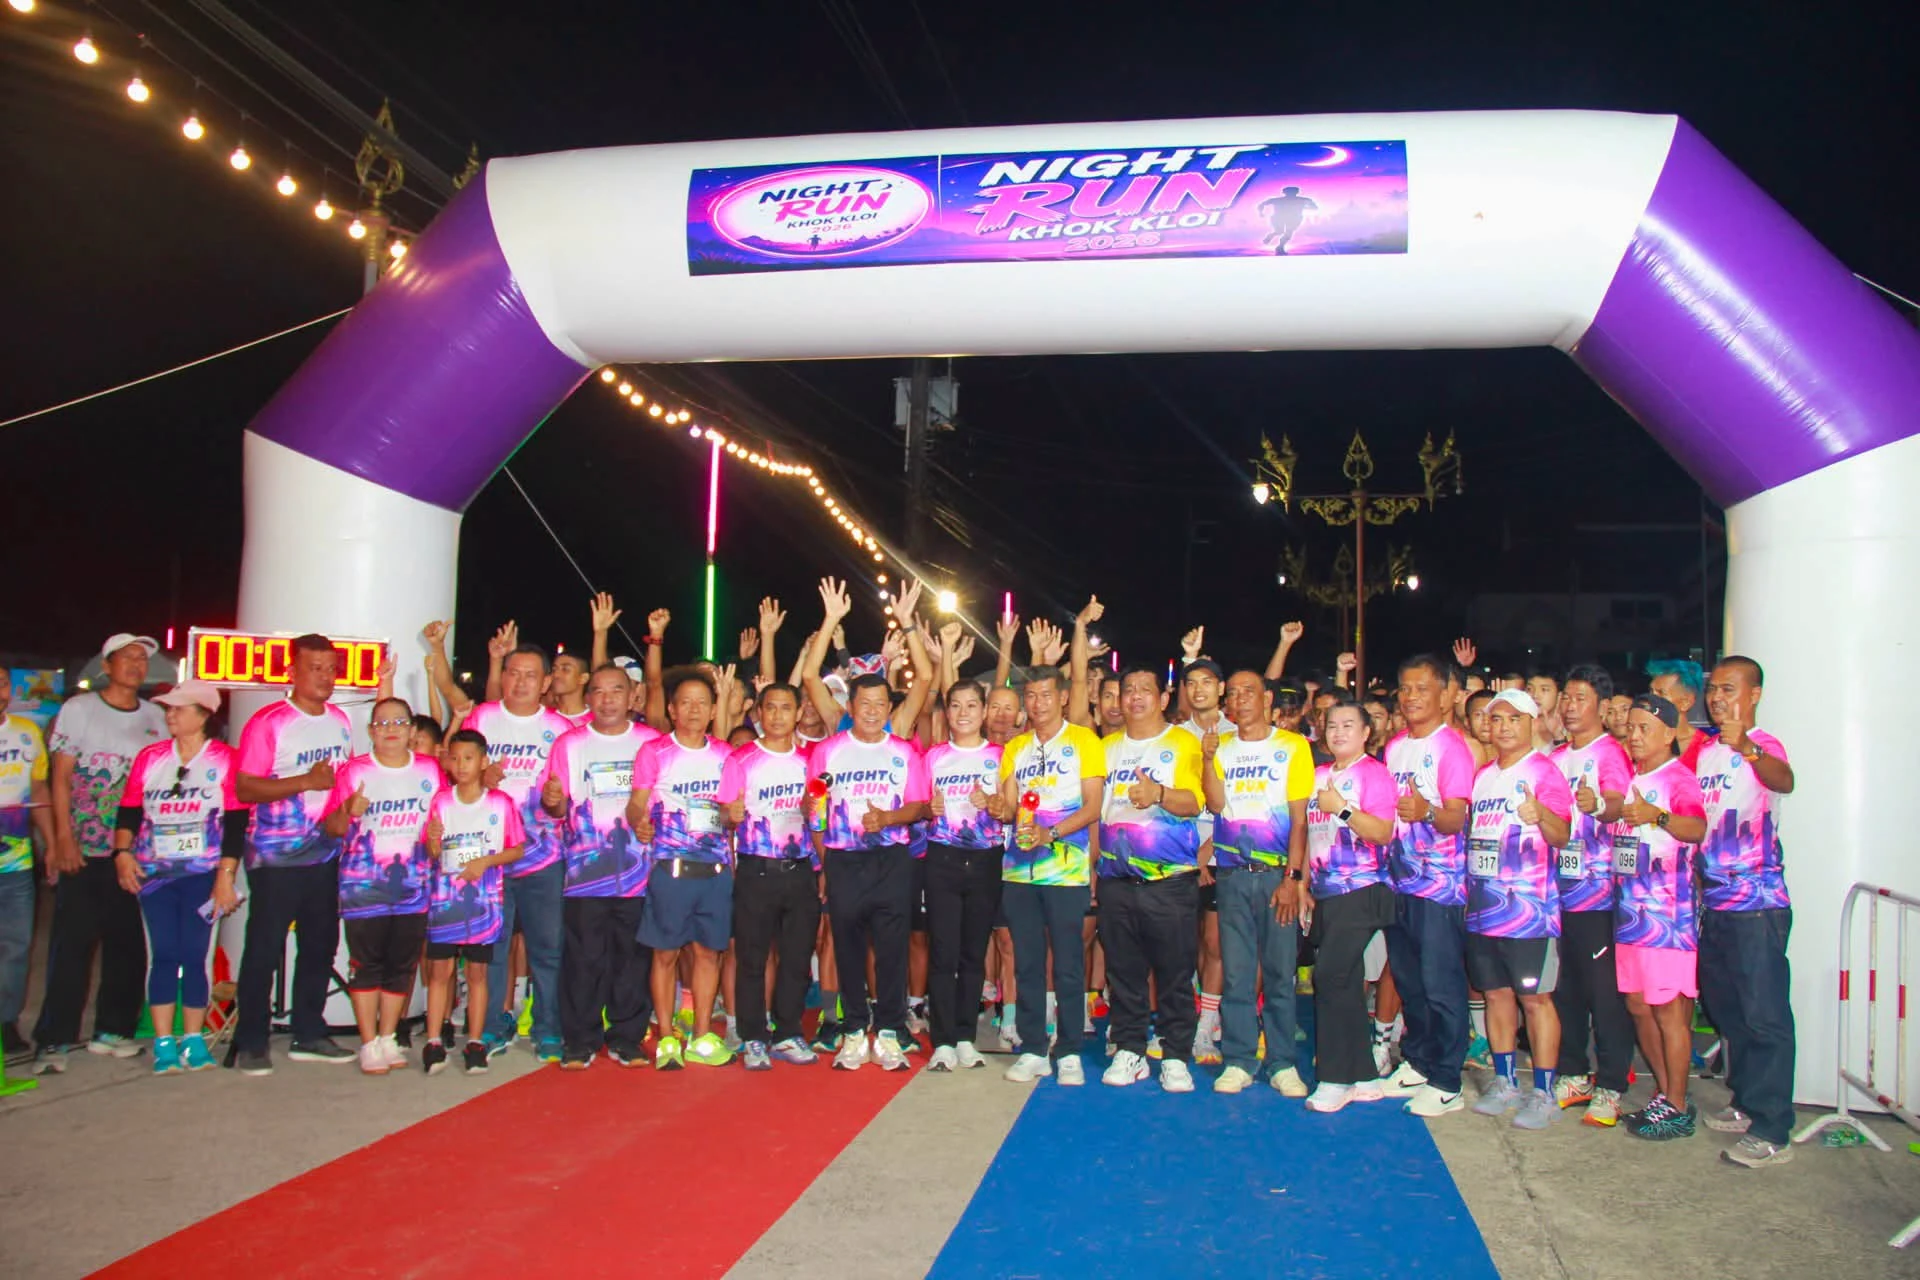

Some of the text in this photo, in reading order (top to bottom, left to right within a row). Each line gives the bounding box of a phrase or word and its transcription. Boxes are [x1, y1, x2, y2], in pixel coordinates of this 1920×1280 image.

[977, 144, 1269, 187] NIGHT
[758, 178, 883, 205] NIGHT
[774, 191, 892, 223] RUN
[966, 167, 1257, 234] RUN
[786, 212, 878, 229] KHOK KLOI
[811, 222, 853, 234] 2026
[1007, 211, 1224, 242] KHOK KLOI
[1063, 231, 1161, 252] 2026
[296, 745, 342, 767] NIGHT
[487, 743, 538, 757] NIGHT
[835, 769, 889, 785] NIGHT
[671, 779, 721, 795] NIGHT
[759, 782, 805, 801] NIGHT
[852, 782, 890, 797] RUN
[159, 800, 202, 815] RUN
[365, 797, 418, 817] NIGHT
[380, 811, 420, 829] RUN
[177, 837, 200, 851] 247
[1478, 855, 1497, 870] 317
[1619, 853, 1636, 867] 096
